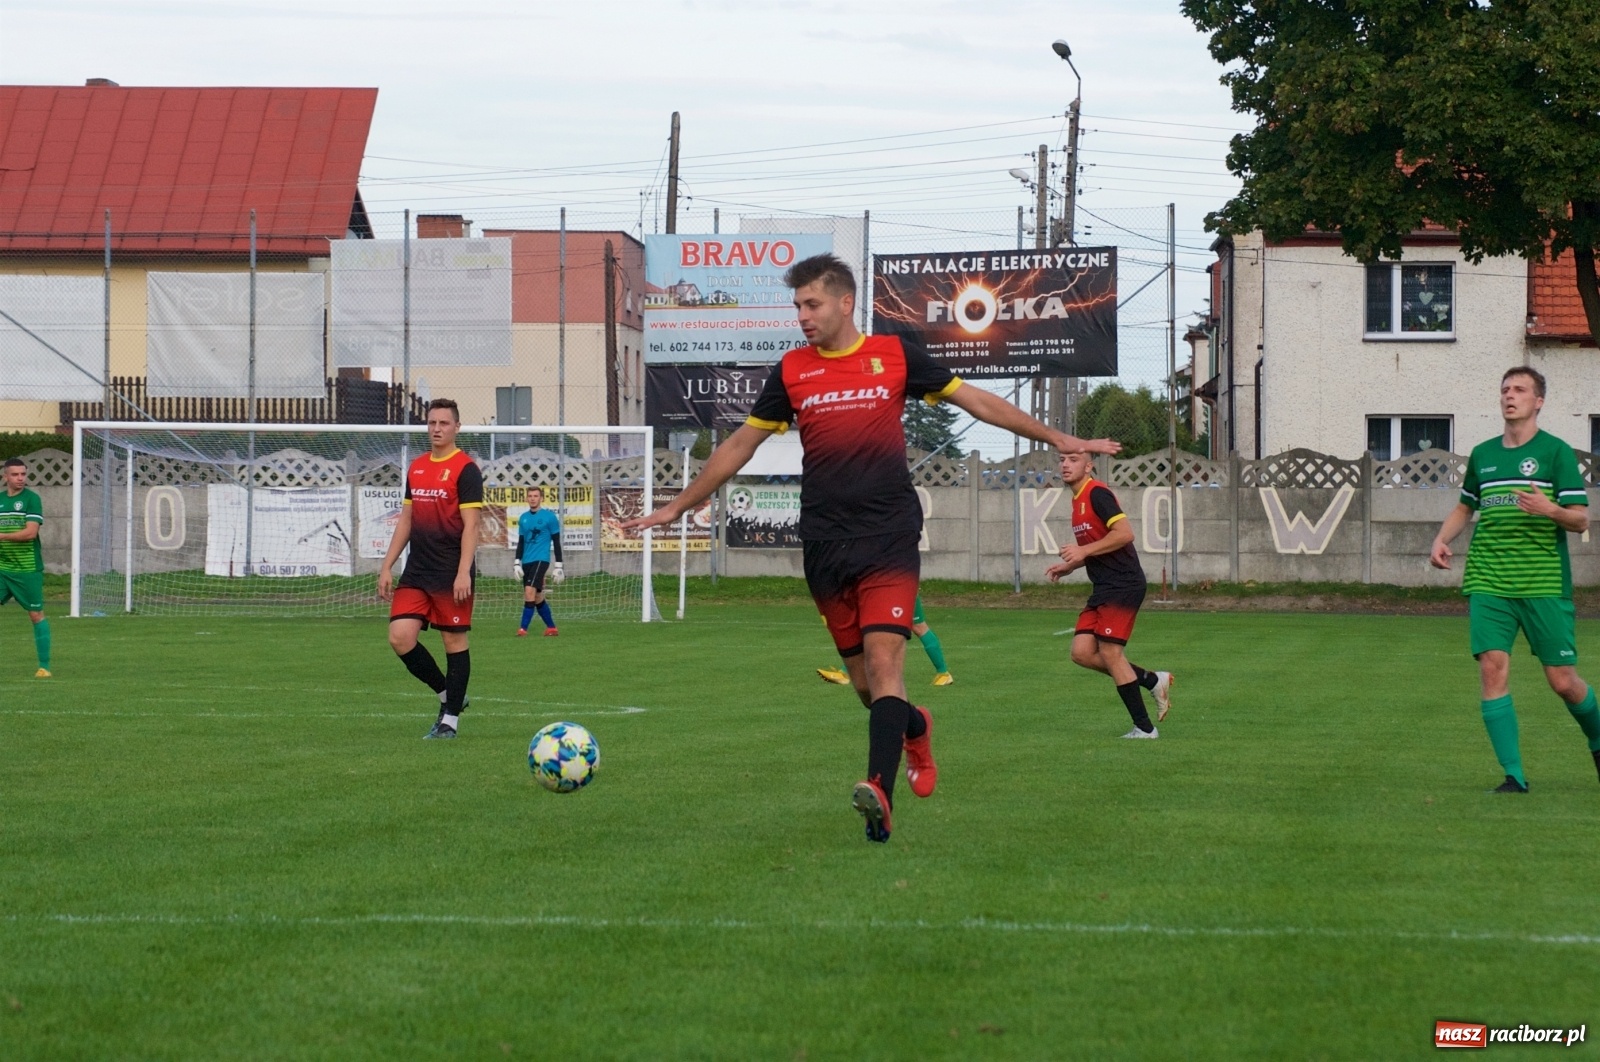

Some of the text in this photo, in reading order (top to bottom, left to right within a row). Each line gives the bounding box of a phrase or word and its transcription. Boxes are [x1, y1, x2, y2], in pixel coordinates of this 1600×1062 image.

[681, 241, 796, 267] BRAVO
[883, 253, 1109, 275] INSTALACJE ELEKTRYCZNE
[707, 276, 743, 288] DOM
[927, 284, 1069, 334] FIOŁKA
[650, 318, 801, 331] www.restauracjabravo.co
[650, 342, 666, 352] tel.
[670, 342, 688, 351] 602
[692, 342, 711, 351] 744
[715, 341, 736, 353] 173,
[740, 341, 753, 351] 48
[756, 341, 775, 350] 606
[778, 340, 791, 350] 27
[949, 363, 1041, 374] www.fiolka.com.pl
[801, 385, 890, 410] mazur
[815, 401, 877, 414] www.mazur-sc.pl
[364, 490, 401, 498] USŁUGI
[755, 491, 779, 500] JEDEN
[781, 491, 790, 500] ZA
[756, 501, 791, 509] WSZYSCY
[1259, 482, 1356, 555] W
